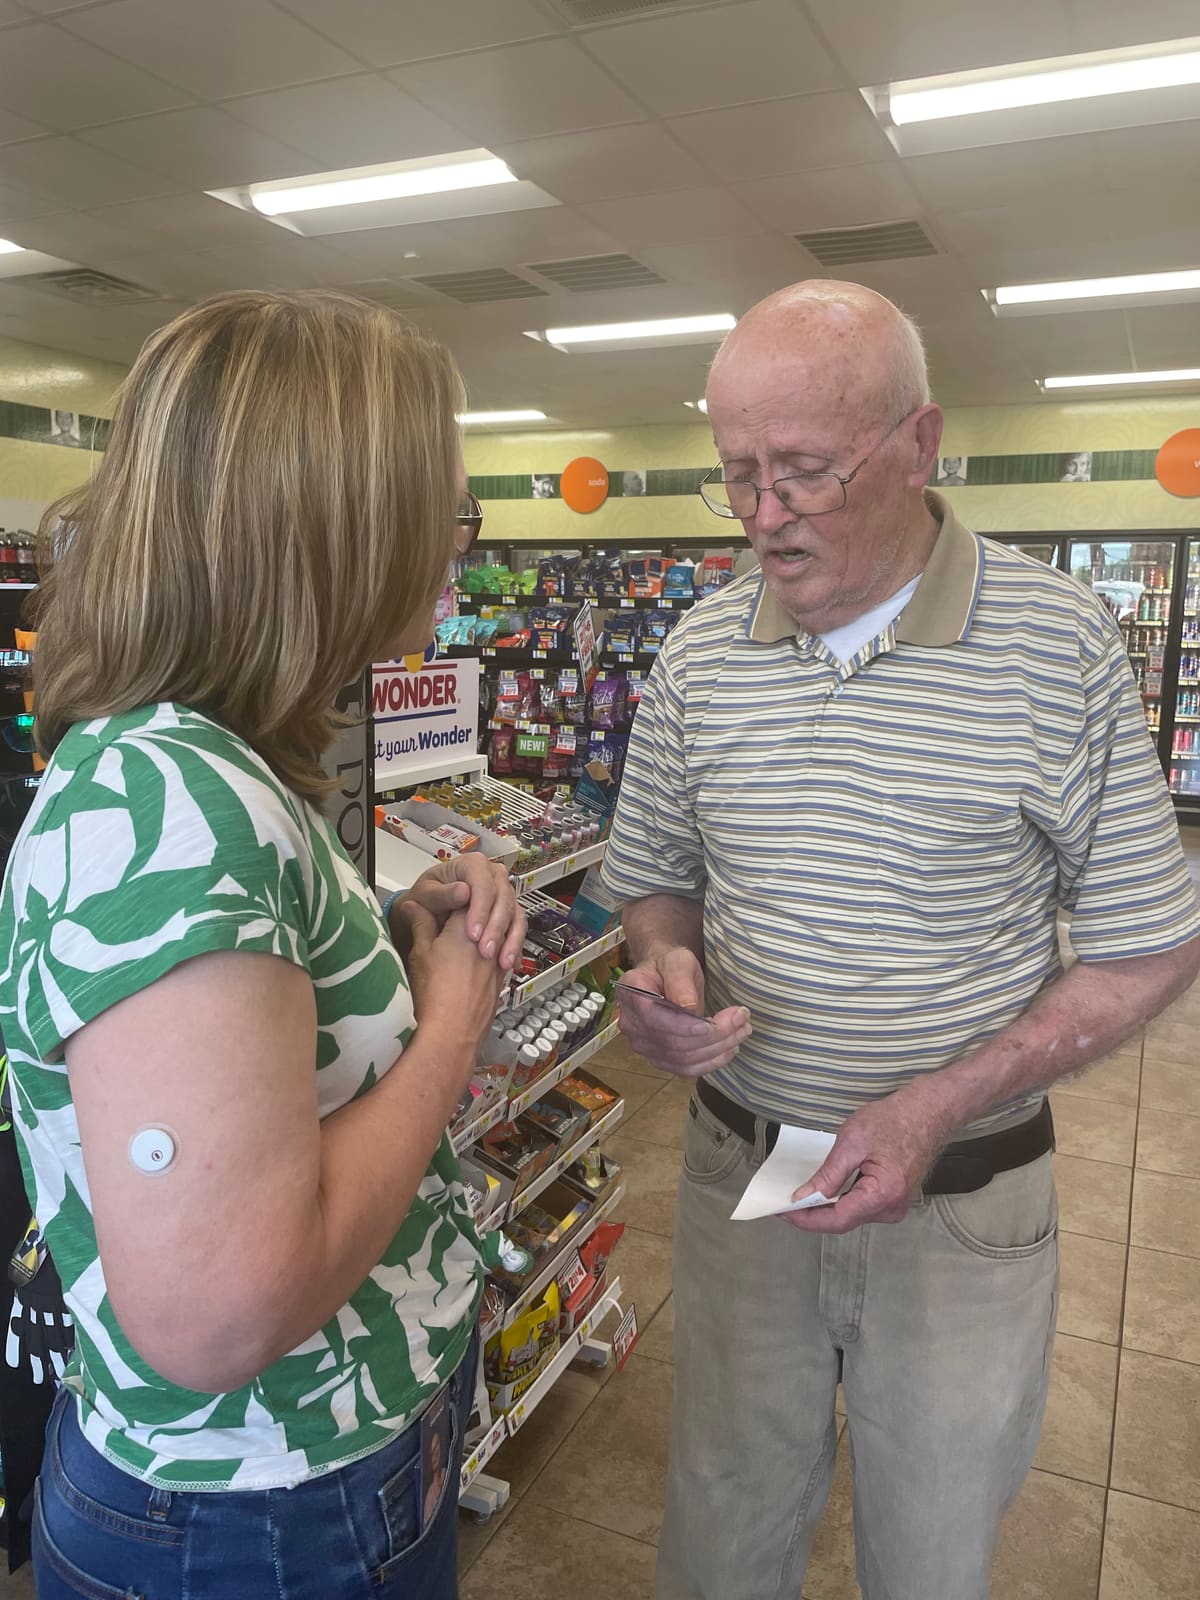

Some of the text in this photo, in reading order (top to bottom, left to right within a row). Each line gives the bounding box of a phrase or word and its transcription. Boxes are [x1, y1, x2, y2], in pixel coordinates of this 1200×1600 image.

[588, 478, 606, 487] soda
[373, 674, 457, 713] WONDER
[386, 736, 418, 761] your
[418, 725, 472, 750] Wonder
[519, 739, 545, 752] NEW!
